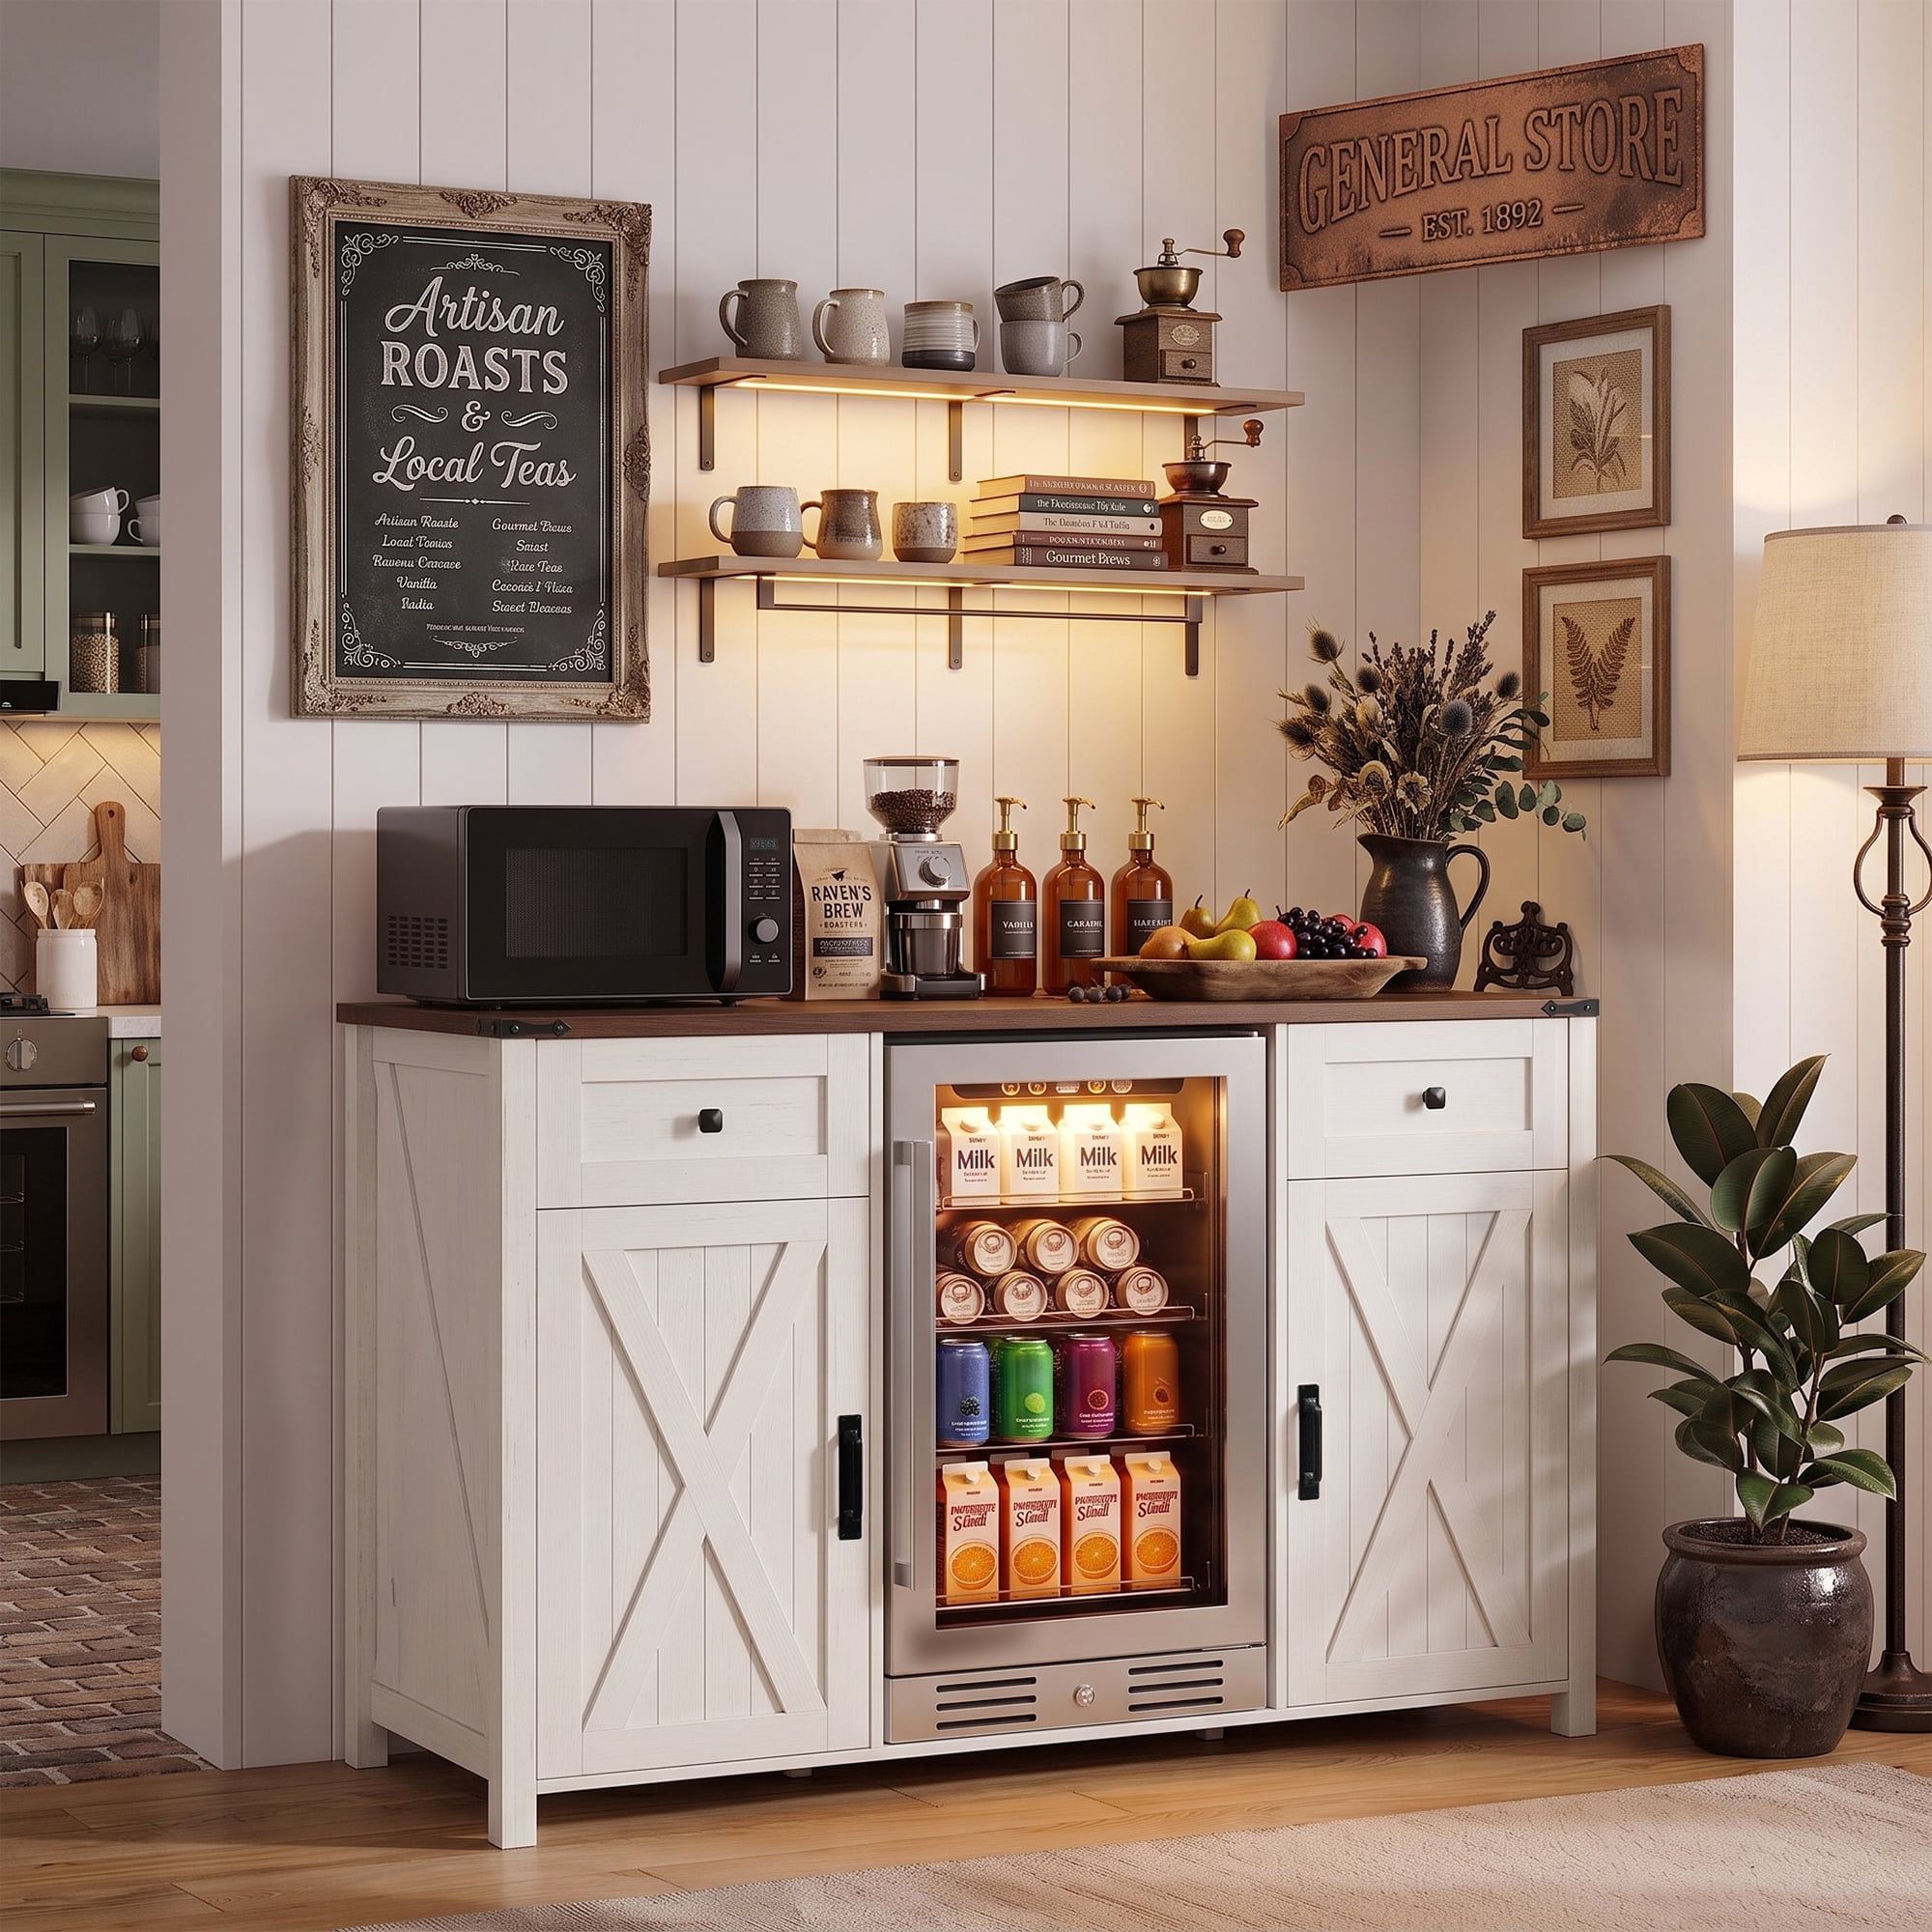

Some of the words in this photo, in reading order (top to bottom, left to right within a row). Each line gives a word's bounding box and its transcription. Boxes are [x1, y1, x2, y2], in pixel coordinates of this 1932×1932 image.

[1298, 116, 1513, 236] GENERAL
[1524, 87, 1684, 187] STORE
[1422, 210, 1474, 242] EST.
[1482, 199, 1544, 235] 1892
[384, 275, 565, 339] Artisan
[380, 340, 570, 395] ROASTS
[461, 401, 491, 433] &
[372, 436, 484, 492] Local
[490, 440, 578, 491] Teas
[1045, 550, 1096, 565] Gourmet
[1098, 551, 1131, 566] Brews
[810, 885, 872, 902] RAVEN'S
[823, 902, 864, 919] BREW
[957, 1149, 995, 1170] Milk
[1016, 1148, 1054, 1168] Milk
[1080, 1146, 1118, 1166] Milk
[1141, 1145, 1178, 1165] Milk
